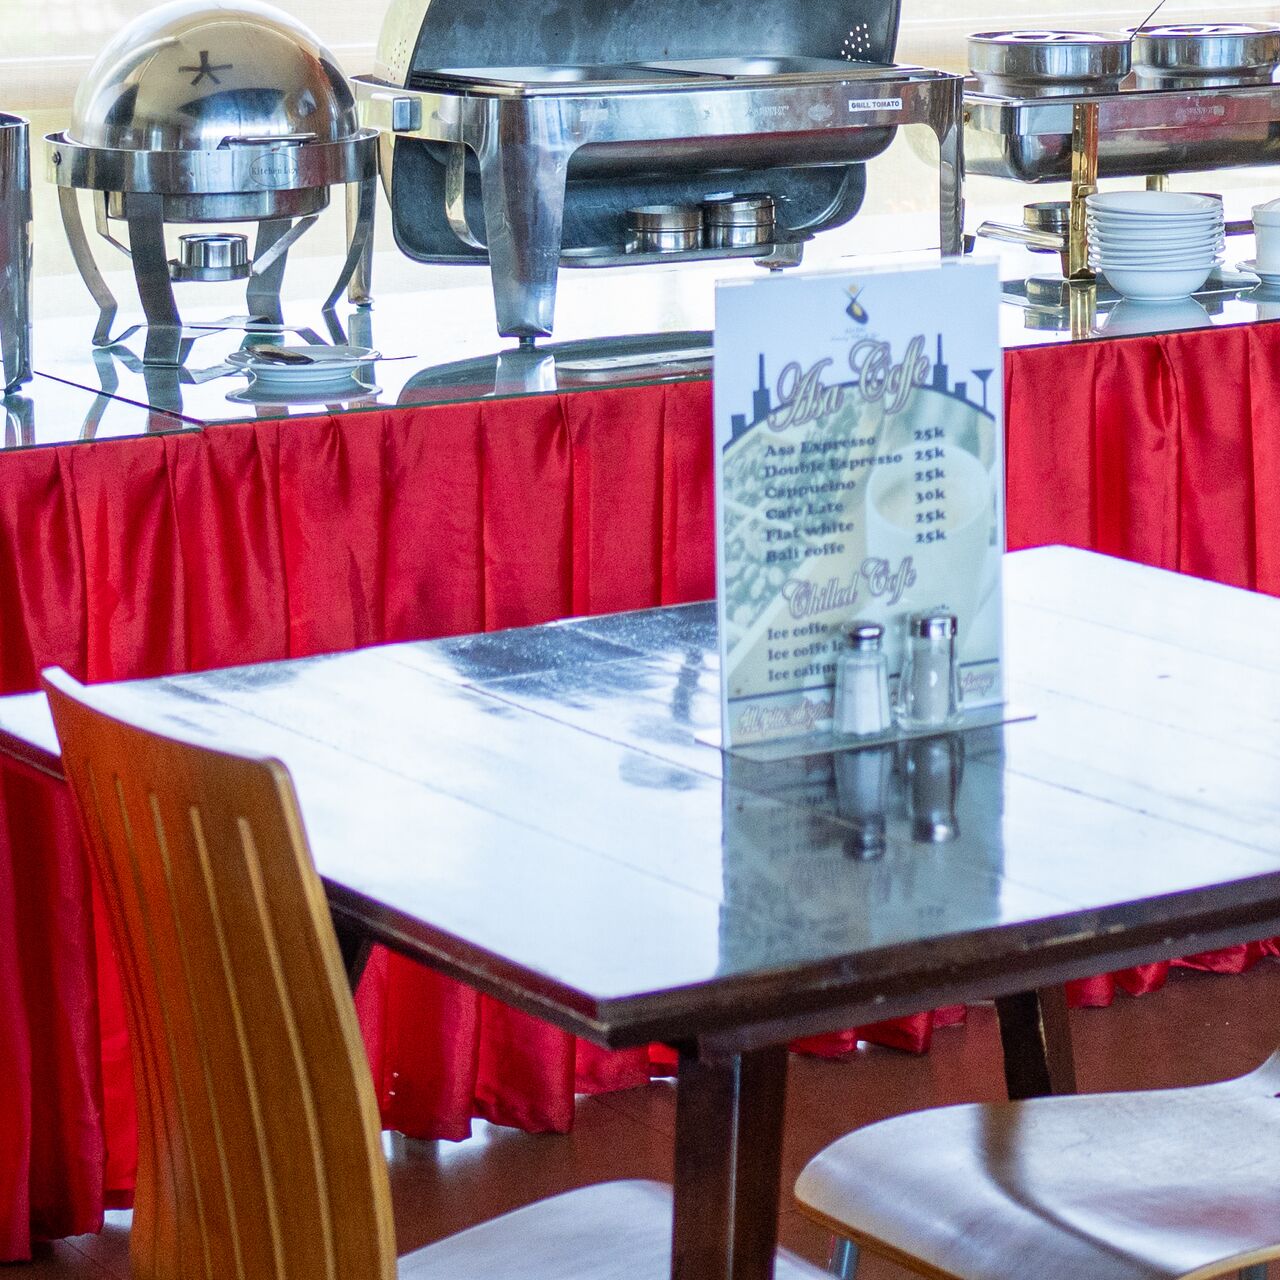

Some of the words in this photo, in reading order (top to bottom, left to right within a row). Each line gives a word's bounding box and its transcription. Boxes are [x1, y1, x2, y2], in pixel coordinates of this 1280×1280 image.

[872, 100, 900, 108] TOMATO
[768, 357, 845, 432] Asa
[764, 444, 795, 458] Asa
[914, 427, 945, 441] 25k
[764, 461, 825, 478] Double
[914, 447, 945, 462] 25k
[764, 480, 856, 499] Cappucino
[915, 467, 946, 482] 25k
[765, 505, 803, 520] Cafe
[806, 502, 845, 516] Late
[915, 488, 946, 504] 30k
[766, 528, 801, 542] Flat
[804, 522, 855, 537] white
[915, 509, 946, 524] 25k
[766, 546, 799, 563] Bali
[915, 529, 946, 544] 25k
[767, 628, 789, 641] Ice
[767, 648, 789, 661] Ice
[768, 668, 790, 682] Ice
